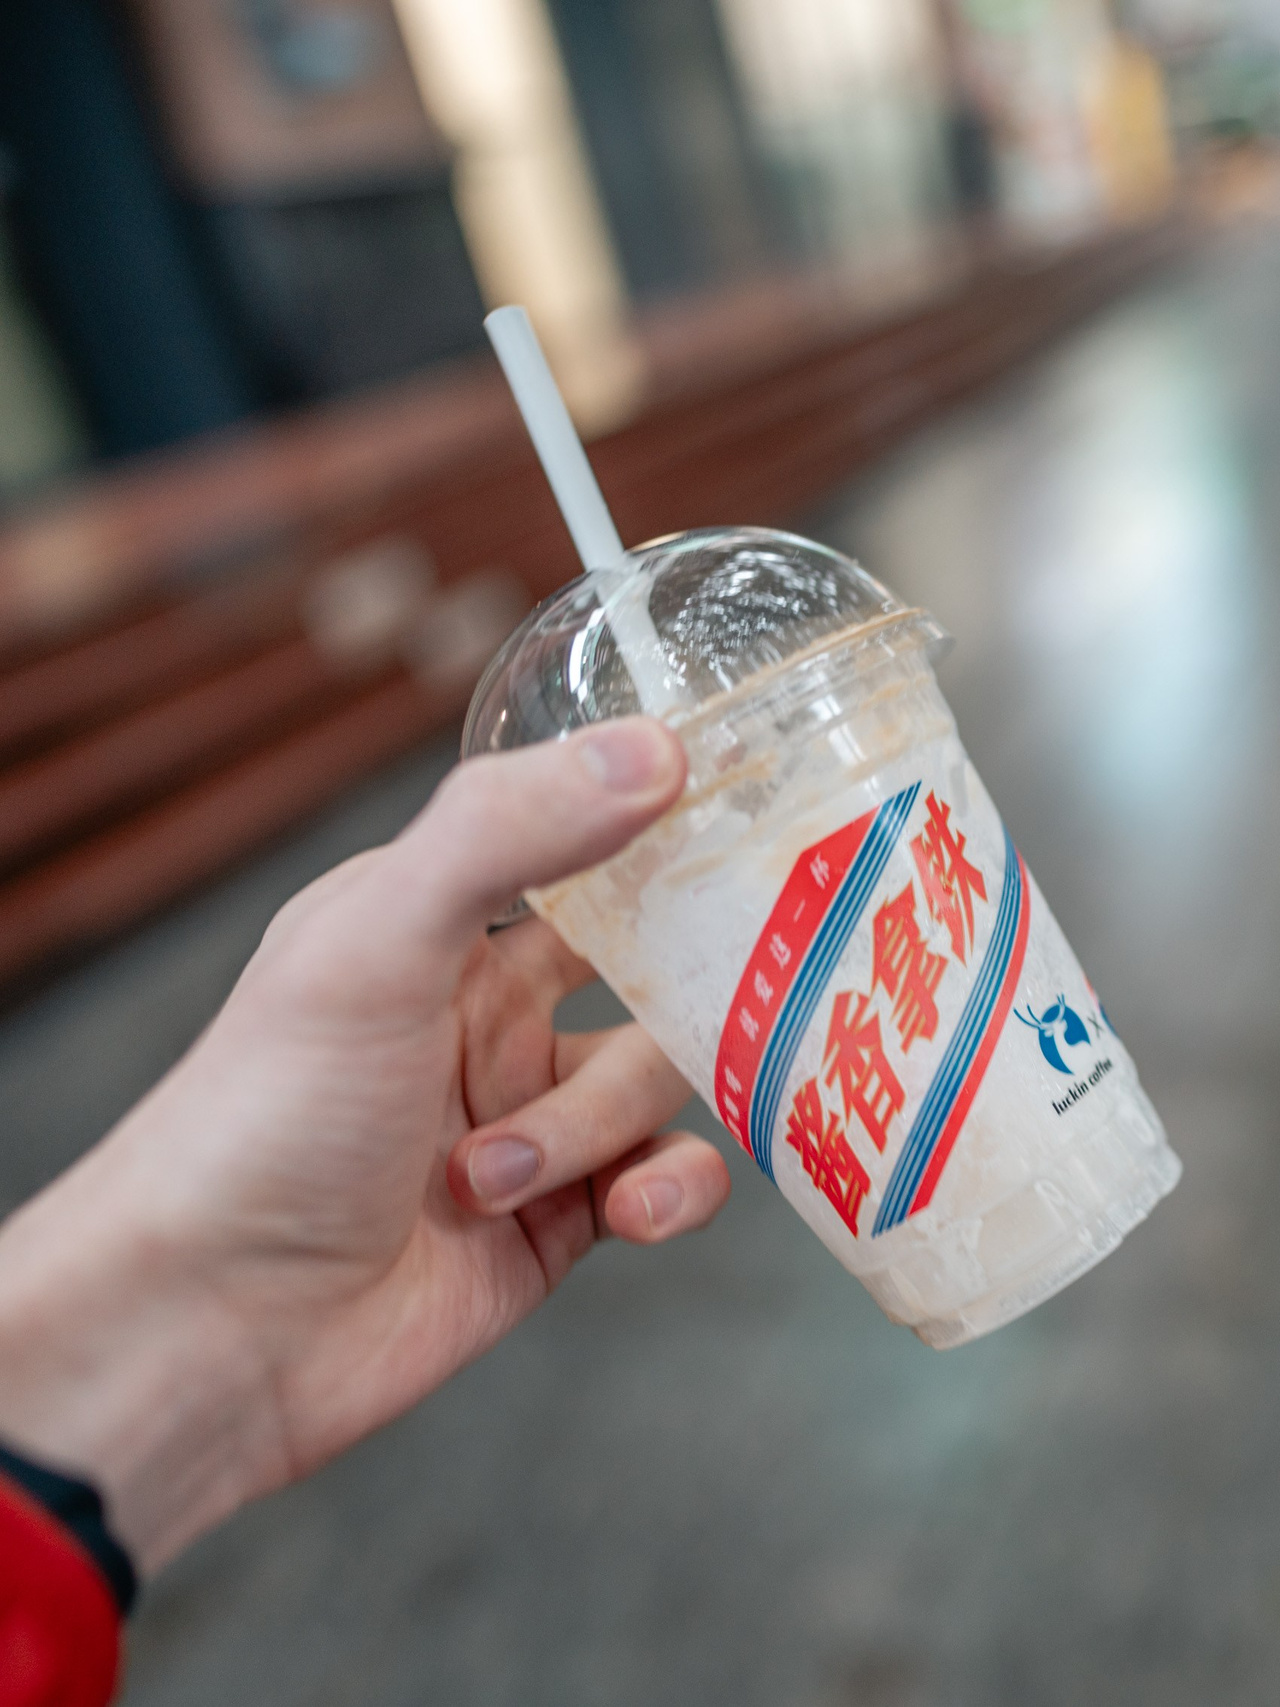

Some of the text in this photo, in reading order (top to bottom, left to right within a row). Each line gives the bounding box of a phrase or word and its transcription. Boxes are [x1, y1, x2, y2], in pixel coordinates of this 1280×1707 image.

[786, 788, 988, 1240] 酱香拿铁
[1052, 1057, 1114, 1116] luckin coffee
